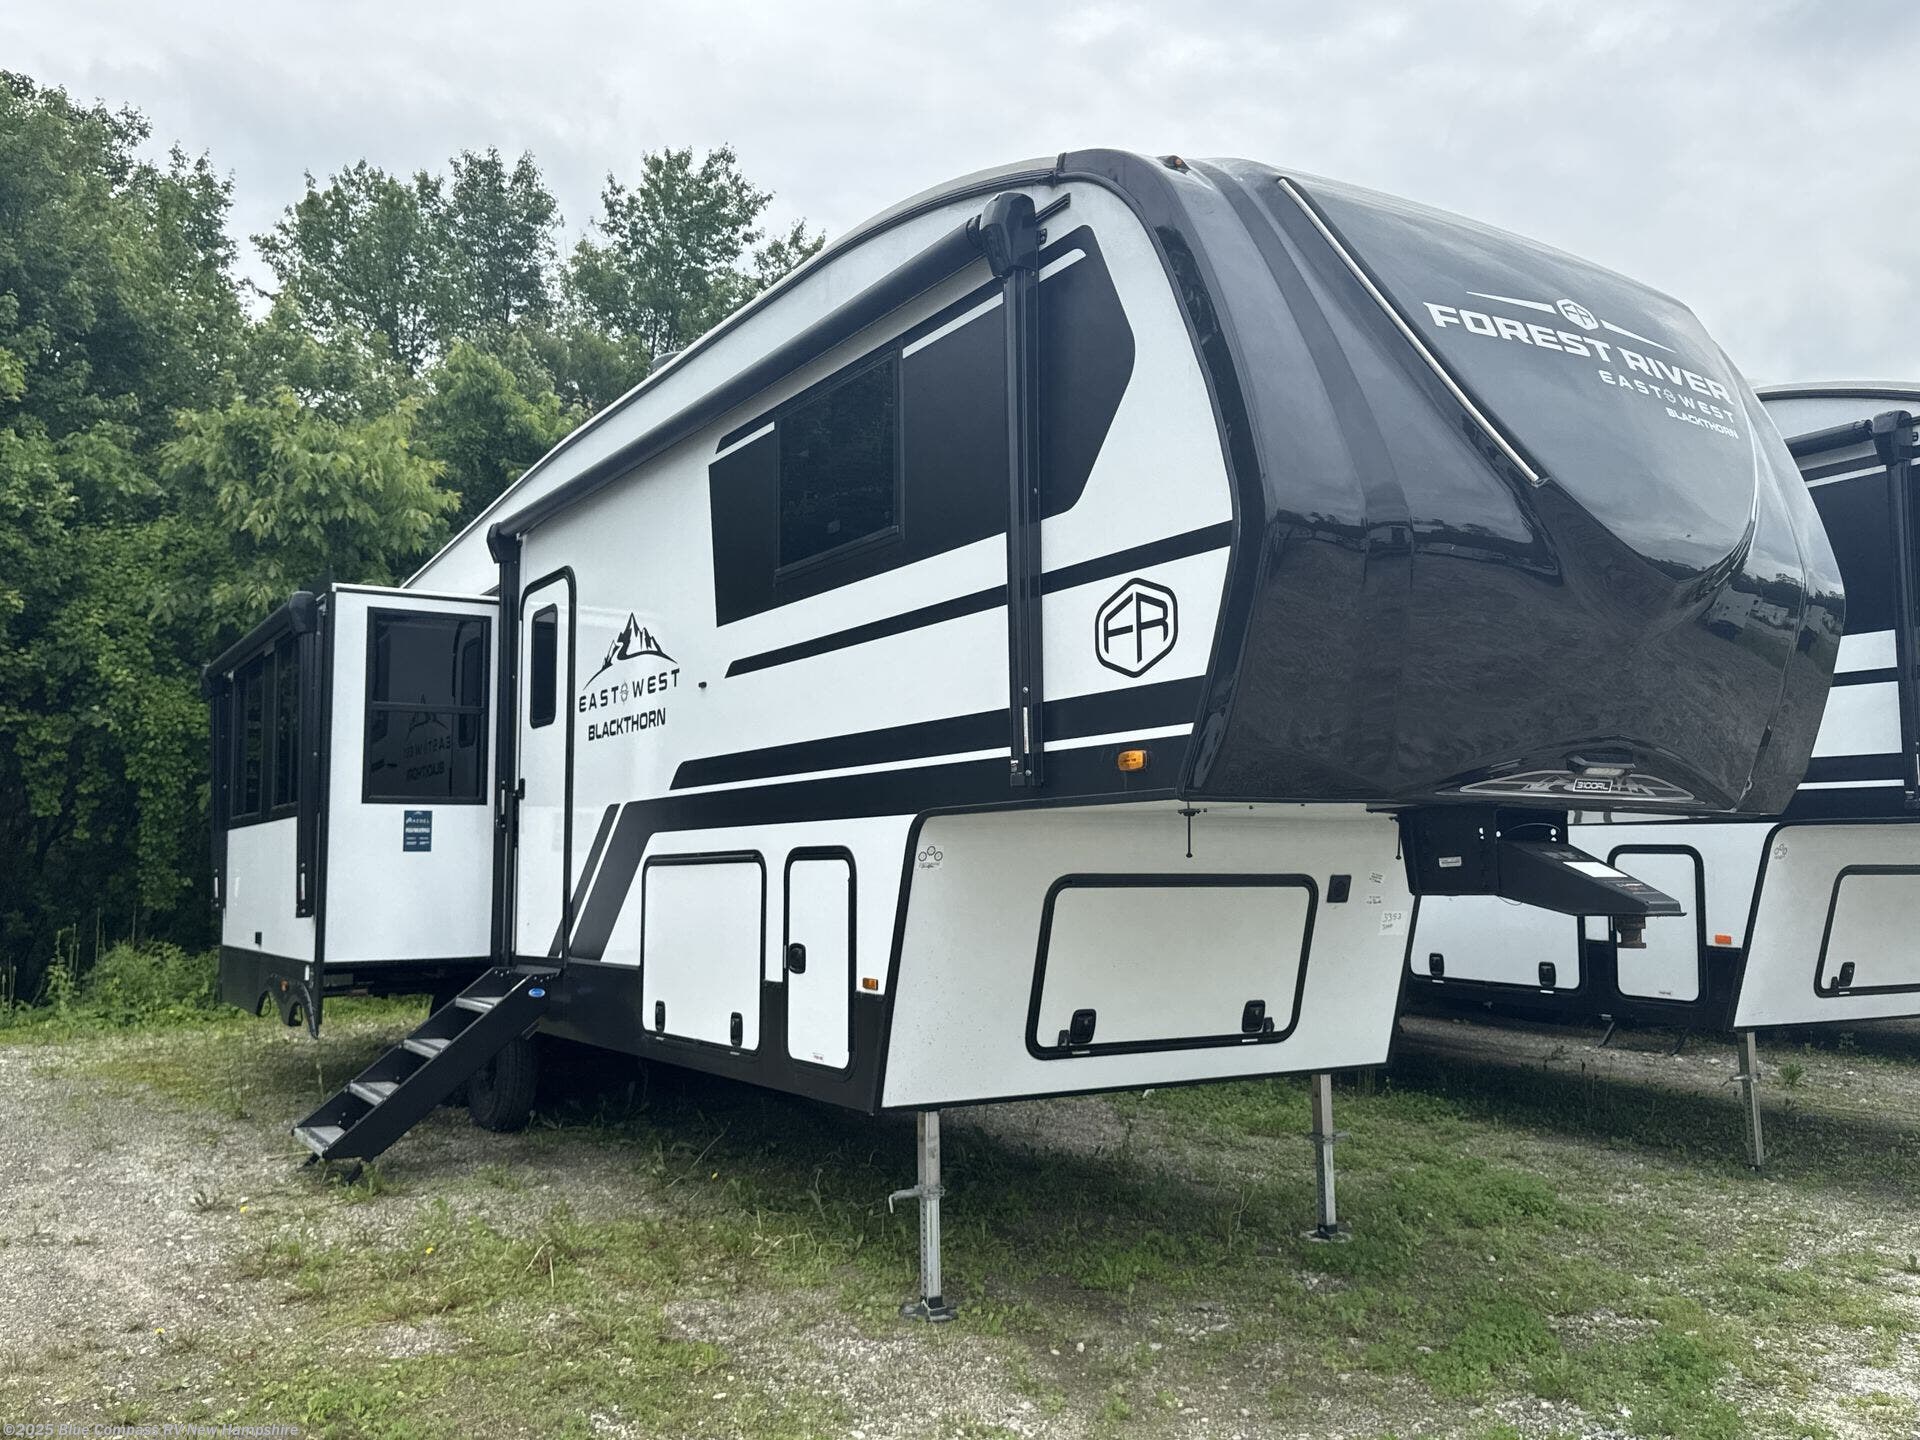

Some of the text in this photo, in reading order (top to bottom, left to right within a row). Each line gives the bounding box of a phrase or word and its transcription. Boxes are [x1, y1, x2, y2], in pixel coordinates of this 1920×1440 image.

[1423, 301, 1735, 405] FOREST RIVER
[1598, 369, 1734, 424] EAST WEST
[1665, 407, 1739, 440] BLACKTHORN
[579, 668, 681, 713] EAST WEST
[588, 707, 667, 742] BLACKTHORN
